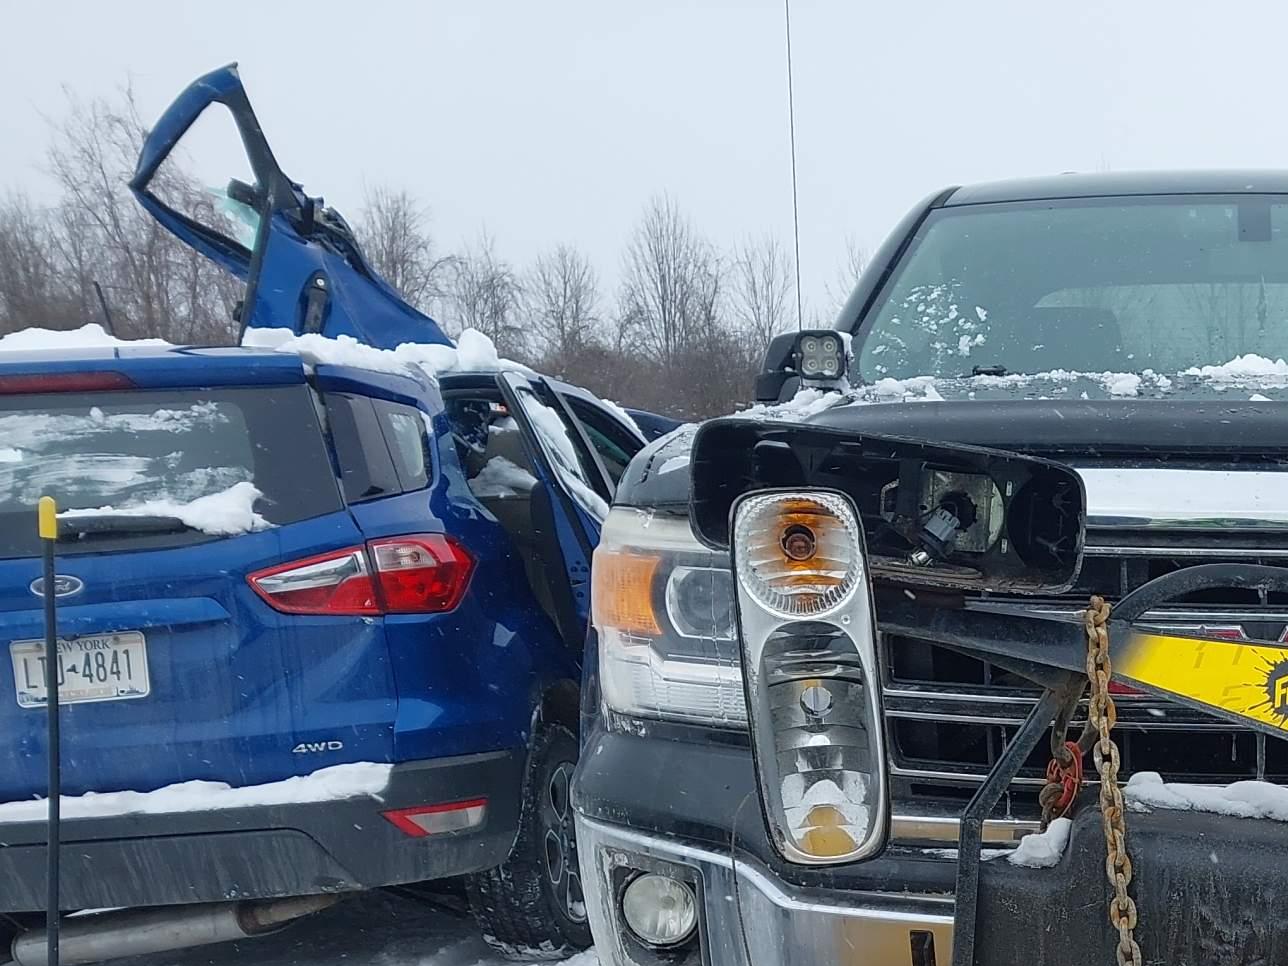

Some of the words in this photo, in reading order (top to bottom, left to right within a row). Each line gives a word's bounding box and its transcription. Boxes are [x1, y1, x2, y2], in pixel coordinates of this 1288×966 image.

[77, 638, 111, 652] YORK
[82, 648, 132, 684] 4841
[292, 741, 343, 753] 4WD
